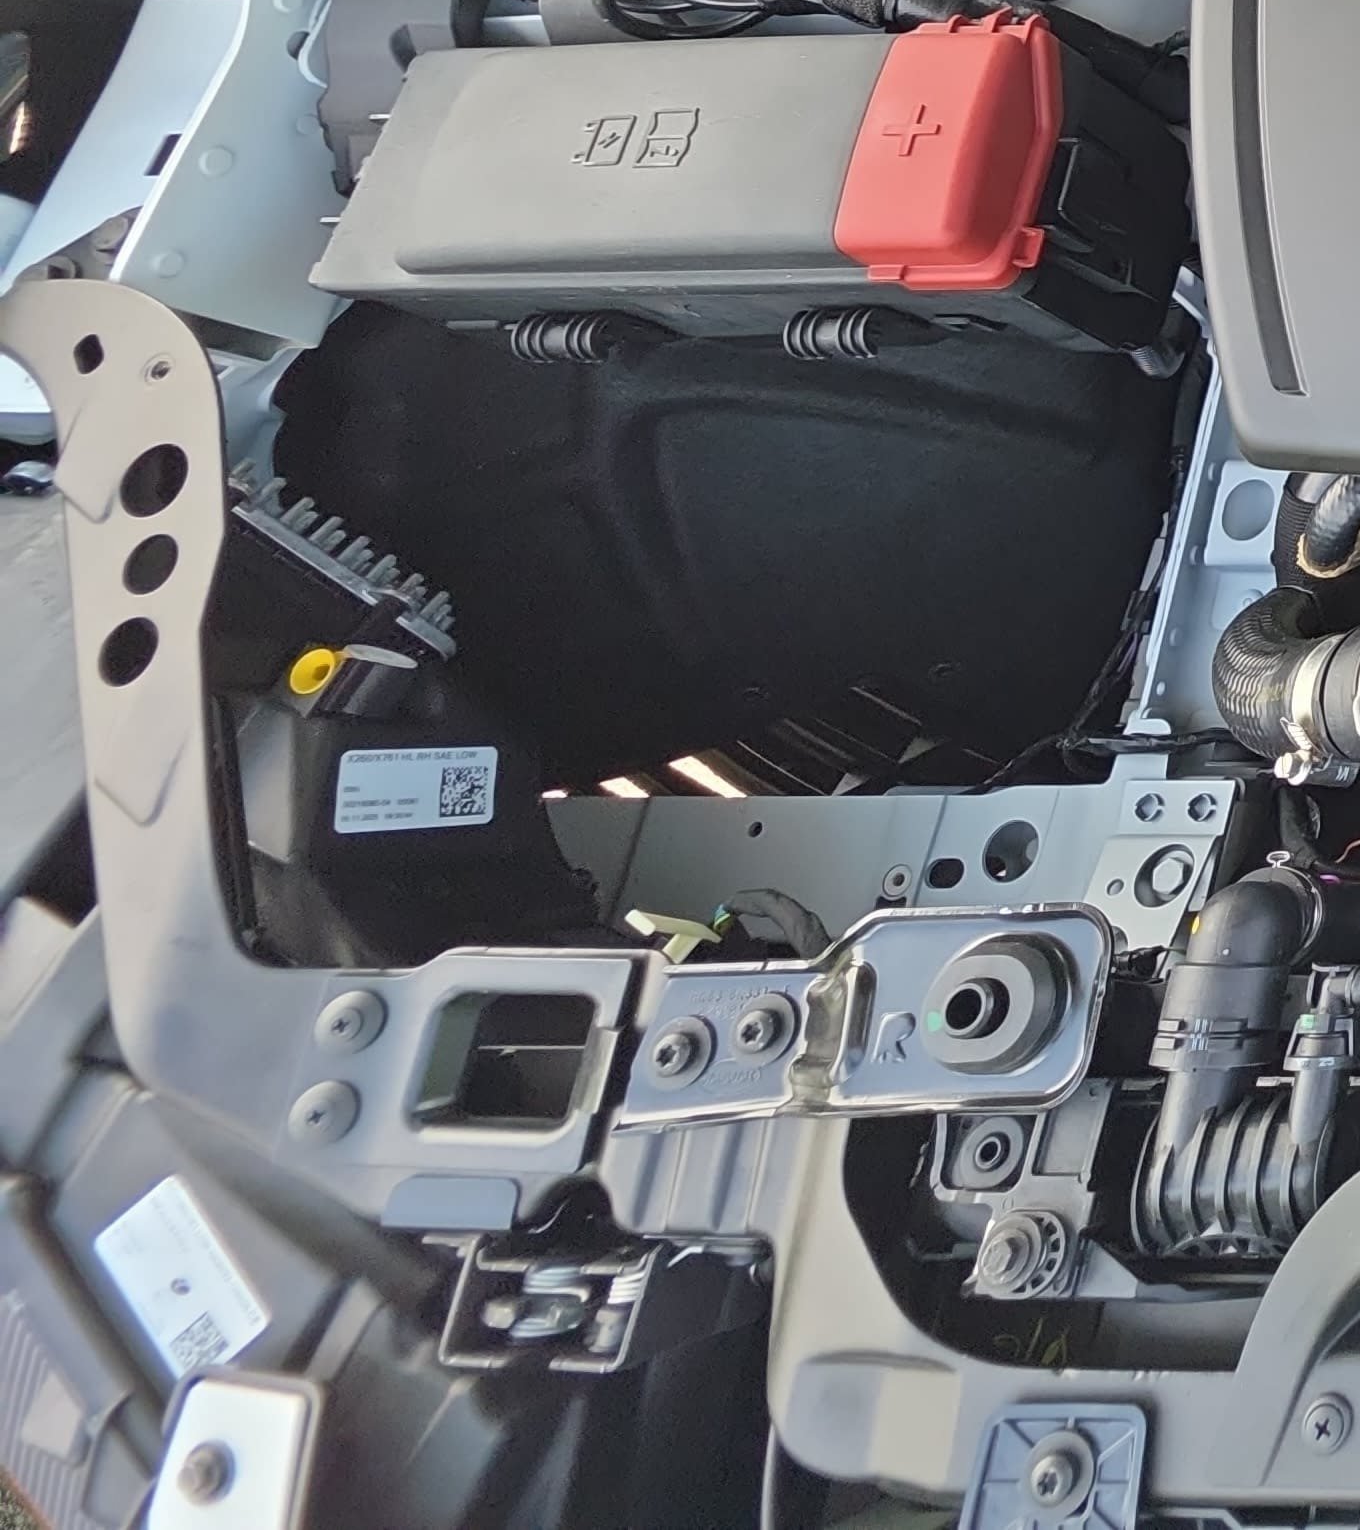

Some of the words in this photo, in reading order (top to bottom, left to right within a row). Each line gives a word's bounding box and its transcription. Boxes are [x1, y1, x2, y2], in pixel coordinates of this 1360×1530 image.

[434, 751, 453, 760] SAE
[456, 750, 478, 760] LOW
[871, 1012, 916, 1063] R
